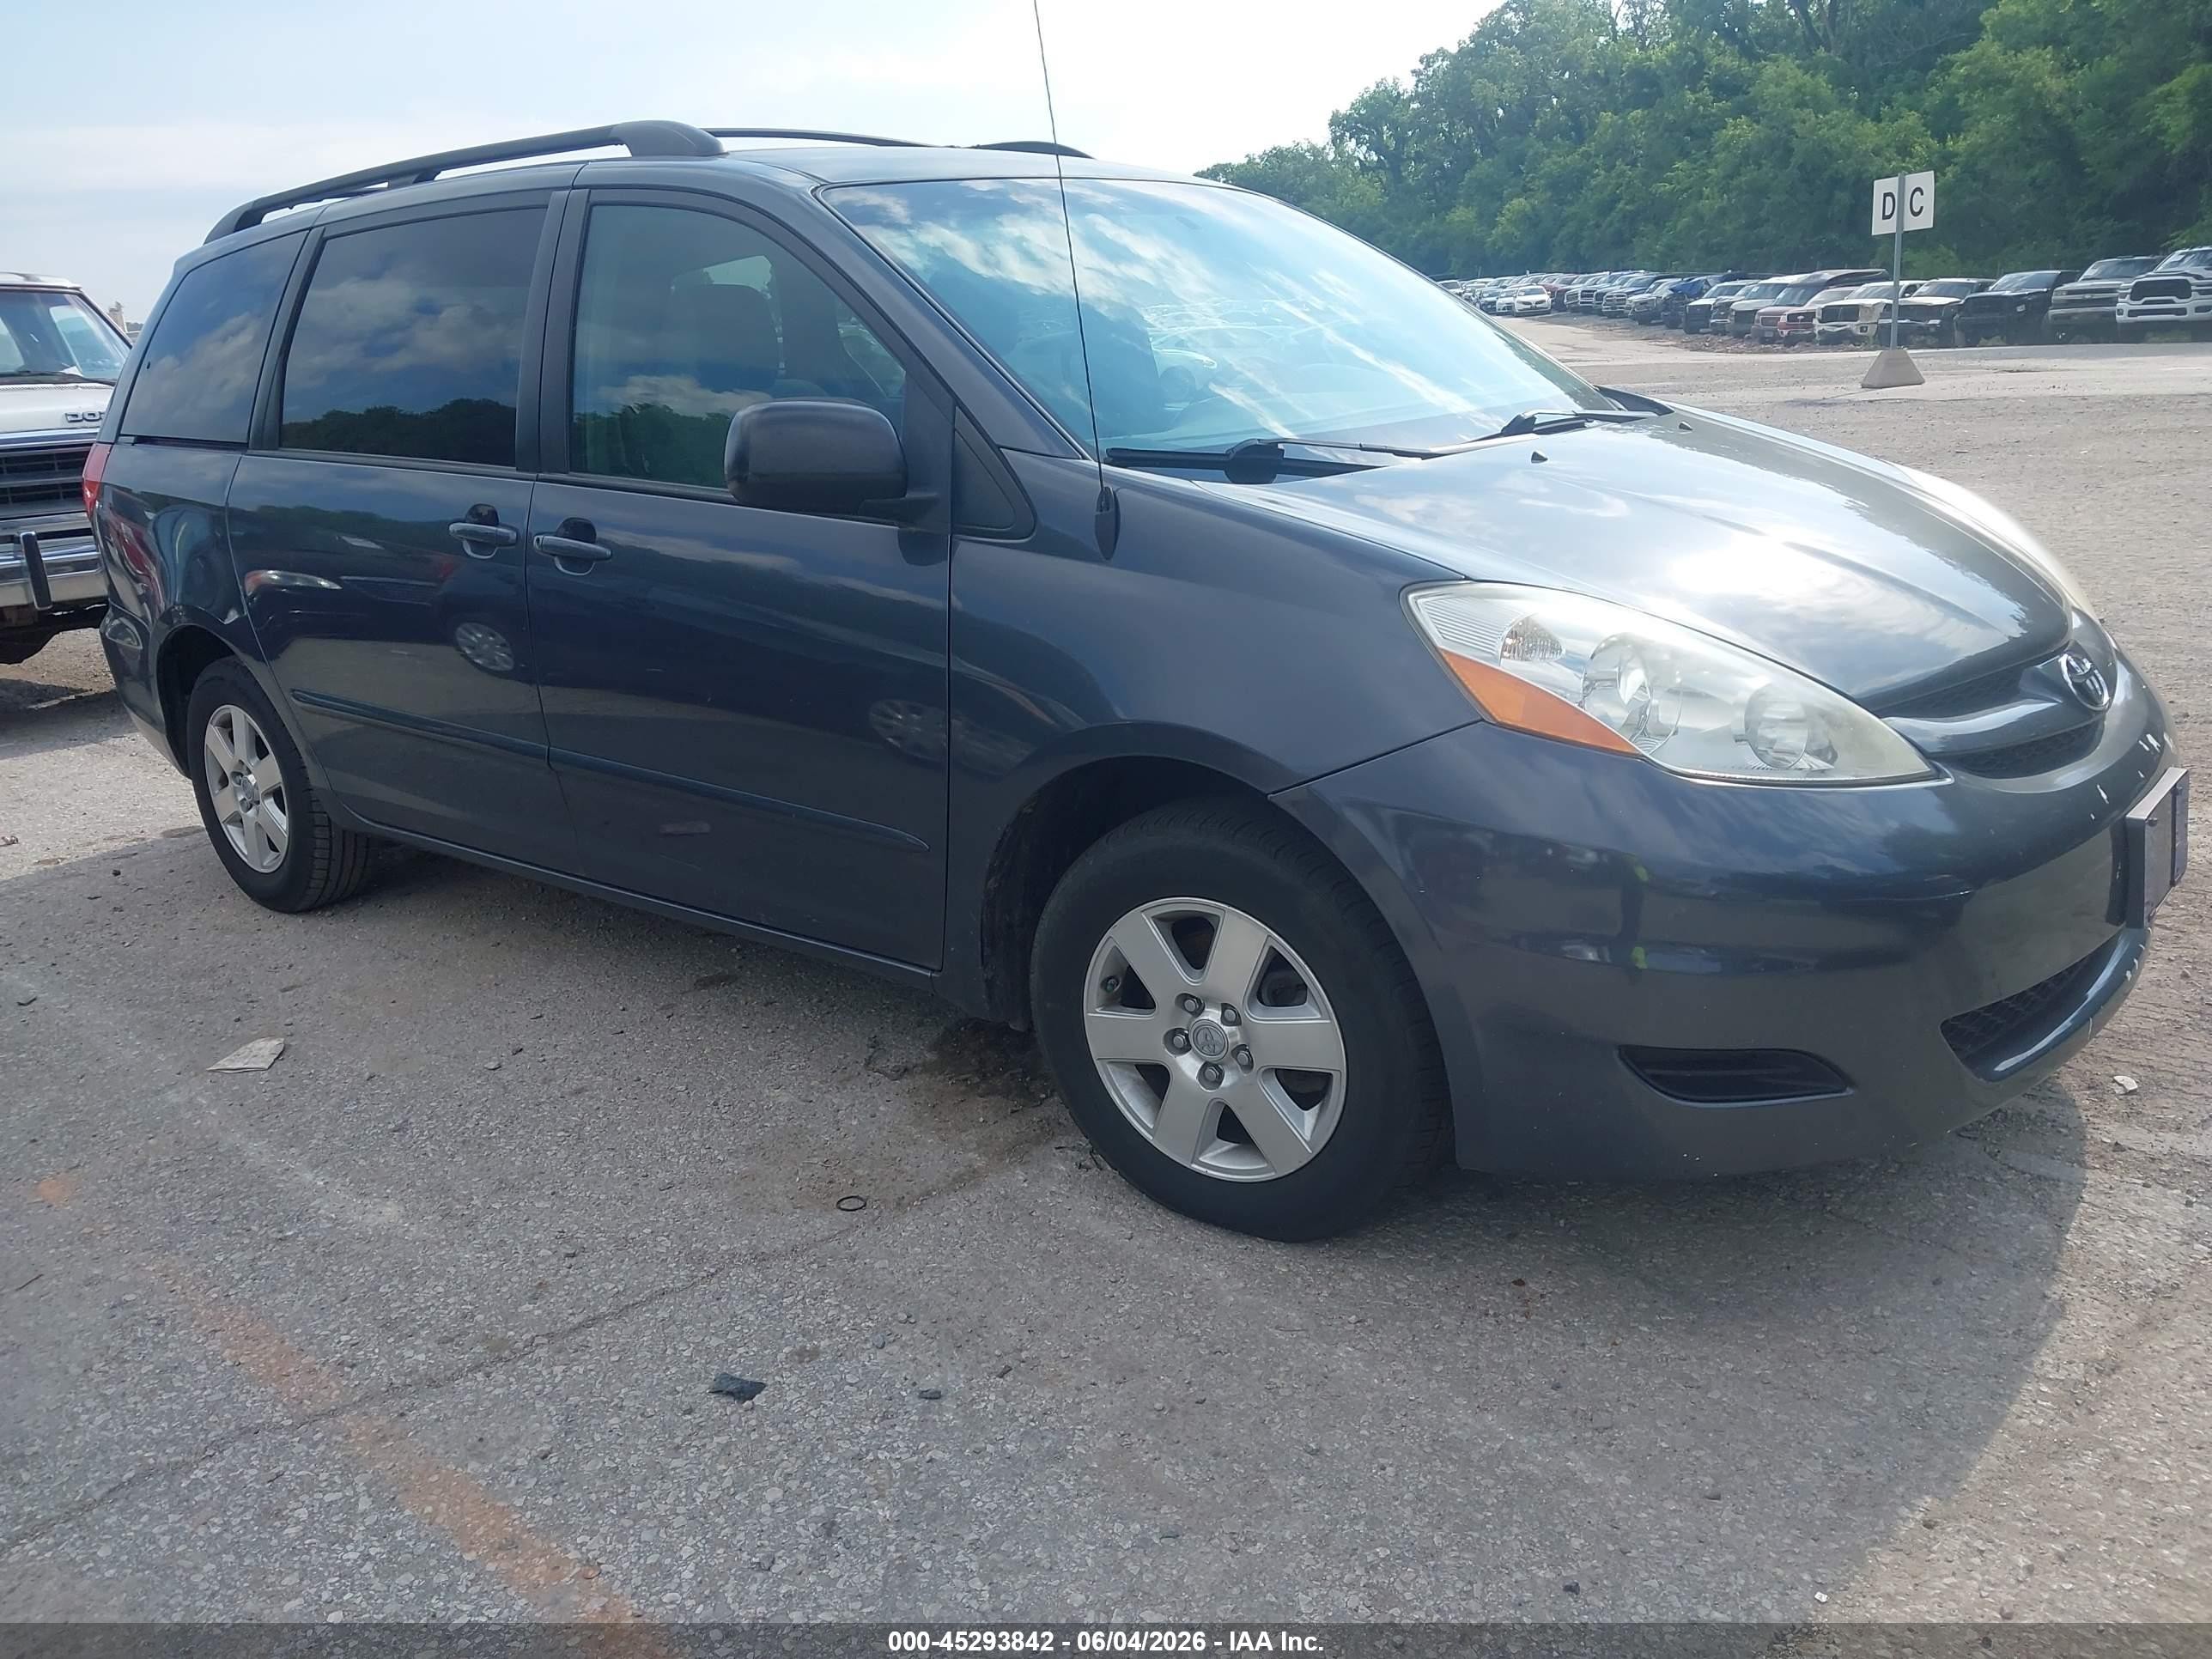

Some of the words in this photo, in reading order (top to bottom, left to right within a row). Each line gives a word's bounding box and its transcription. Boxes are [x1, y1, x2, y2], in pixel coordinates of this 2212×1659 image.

[1881, 191, 1896, 221] D
[1909, 186, 1924, 217] C
[64, 411, 105, 423] DO
